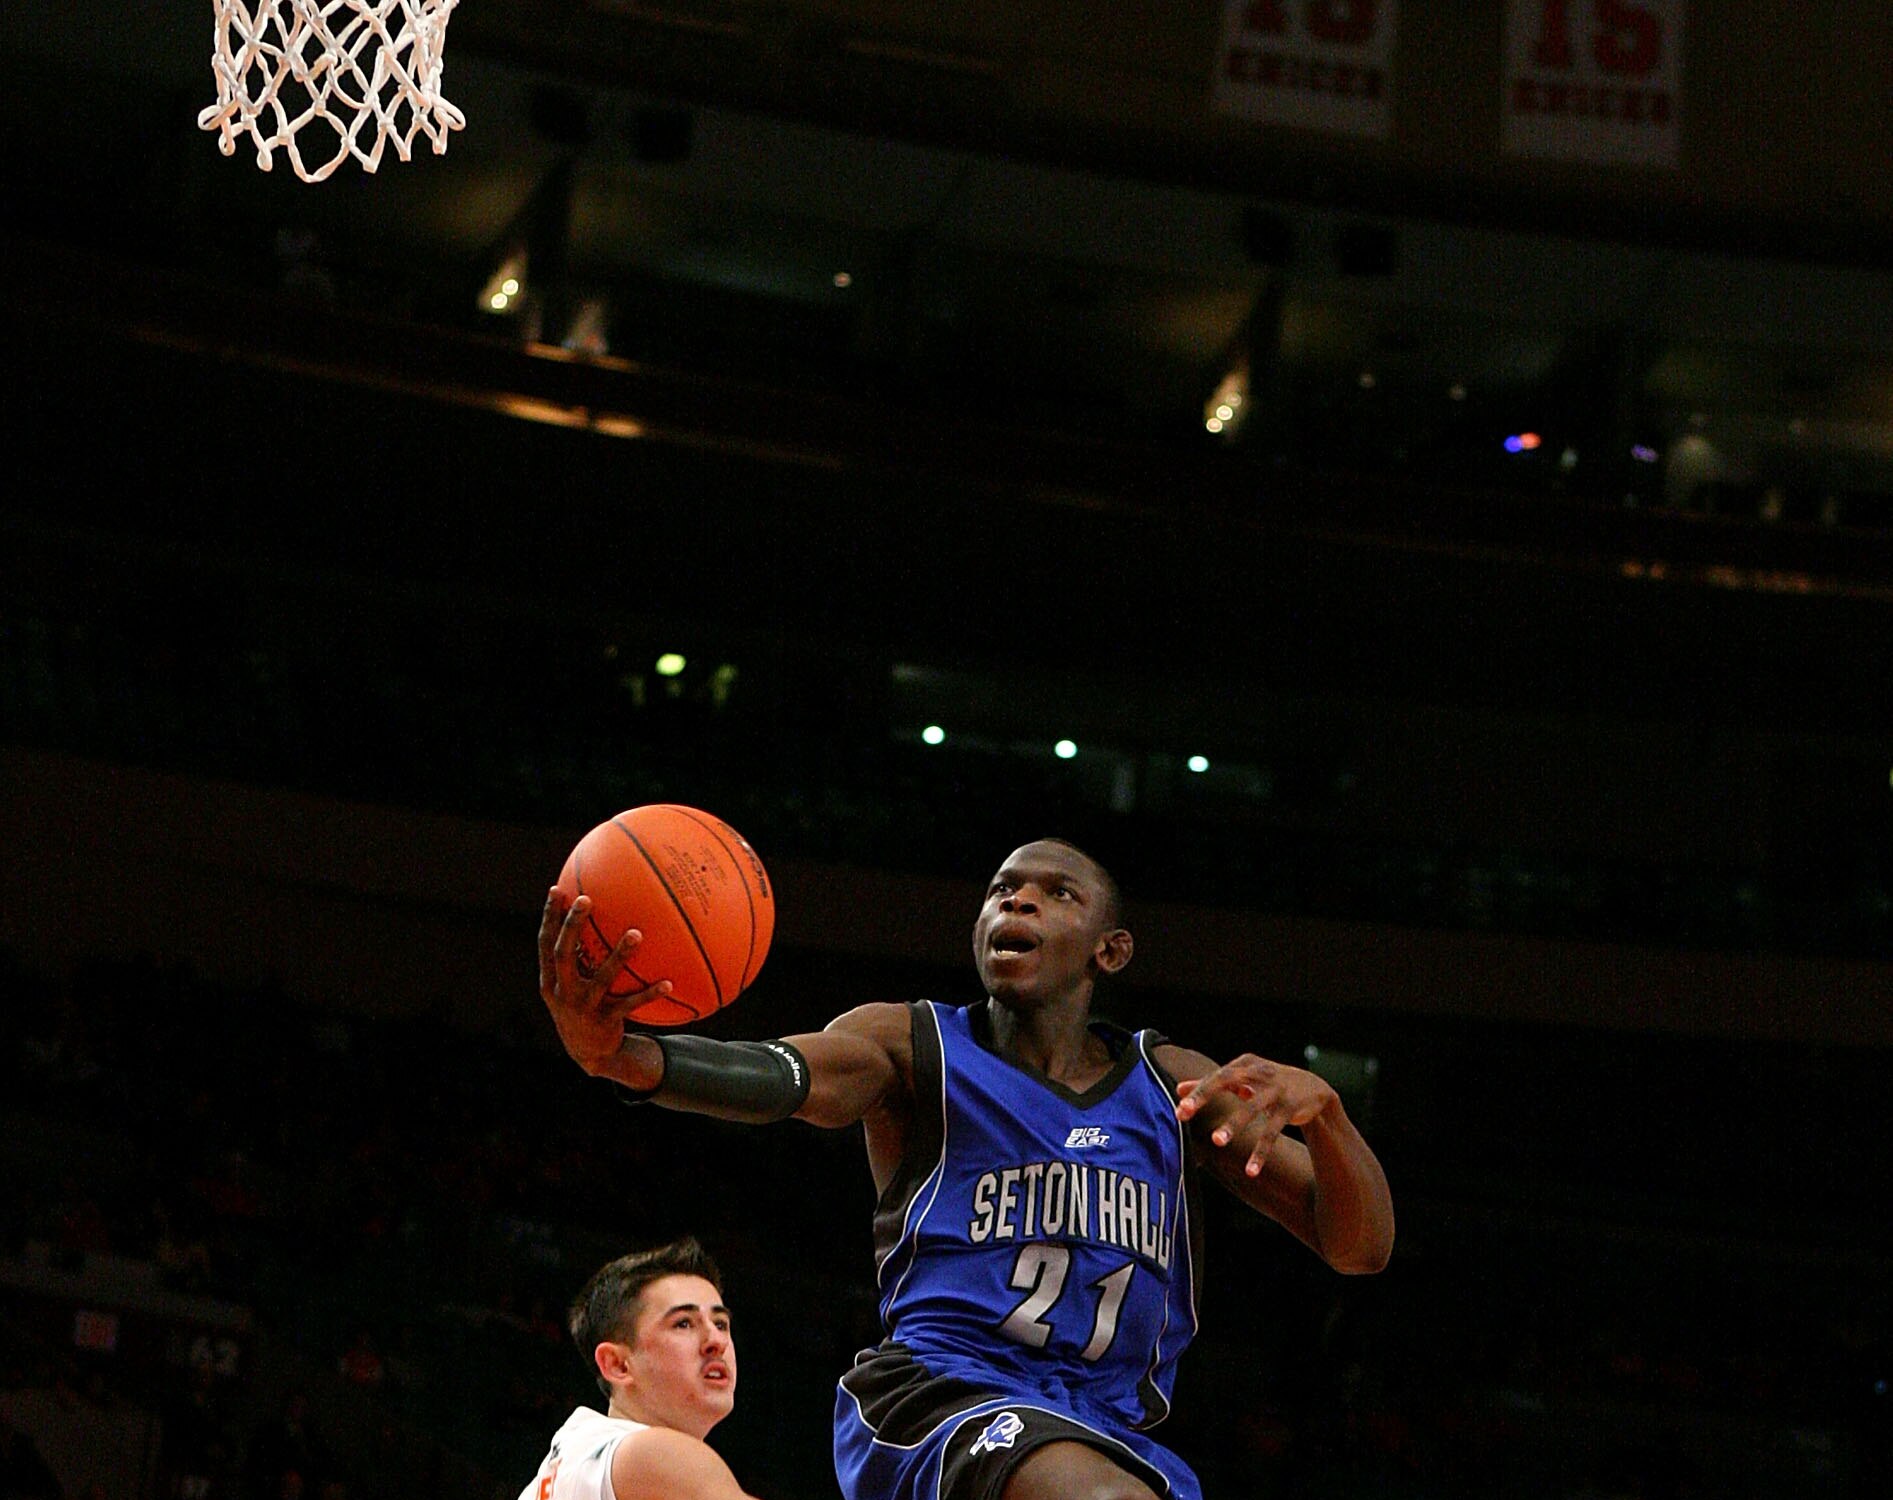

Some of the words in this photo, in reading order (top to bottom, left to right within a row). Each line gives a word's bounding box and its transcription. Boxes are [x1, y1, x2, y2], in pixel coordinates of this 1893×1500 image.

[1065, 1135, 1110, 1148] EAST
[1070, 1127, 1102, 1137] BIG
[969, 1160, 1089, 1245] SETON
[1097, 1167, 1171, 1271] HALL
[998, 1241, 1137, 1364] 21
